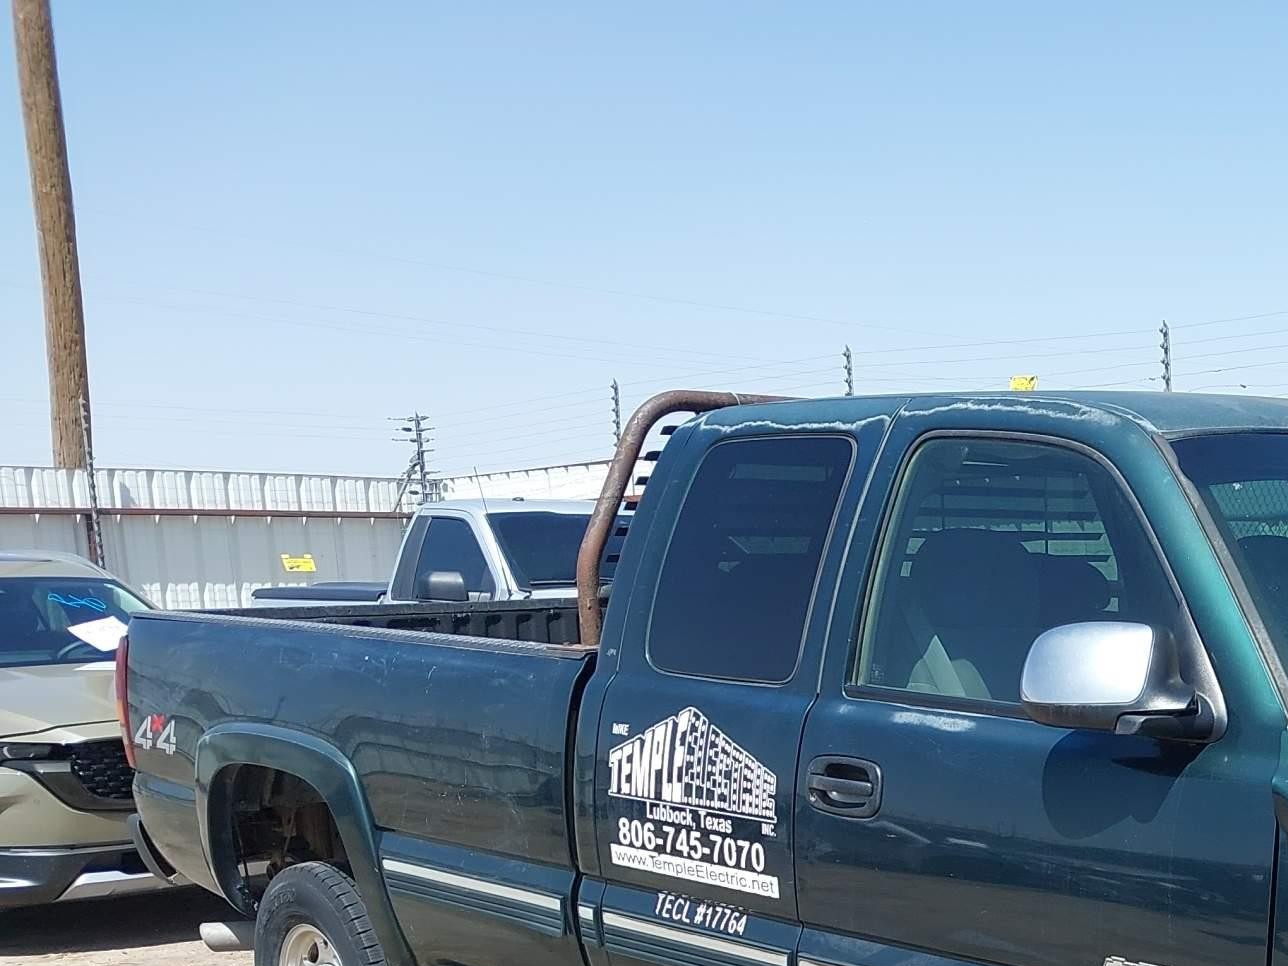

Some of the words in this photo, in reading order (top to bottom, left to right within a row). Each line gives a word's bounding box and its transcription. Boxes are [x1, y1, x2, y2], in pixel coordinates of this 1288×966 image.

[609, 708, 692, 804] TEMPLE
[646, 802, 696, 829] Lubbock,
[699, 811, 733, 834] Texas
[618, 817, 765, 873] 806-745-7070
[615, 850, 775, 894] www.TempleElectric.net
[655, 892, 690, 923] TECL
[694, 903, 747, 936] #17764
